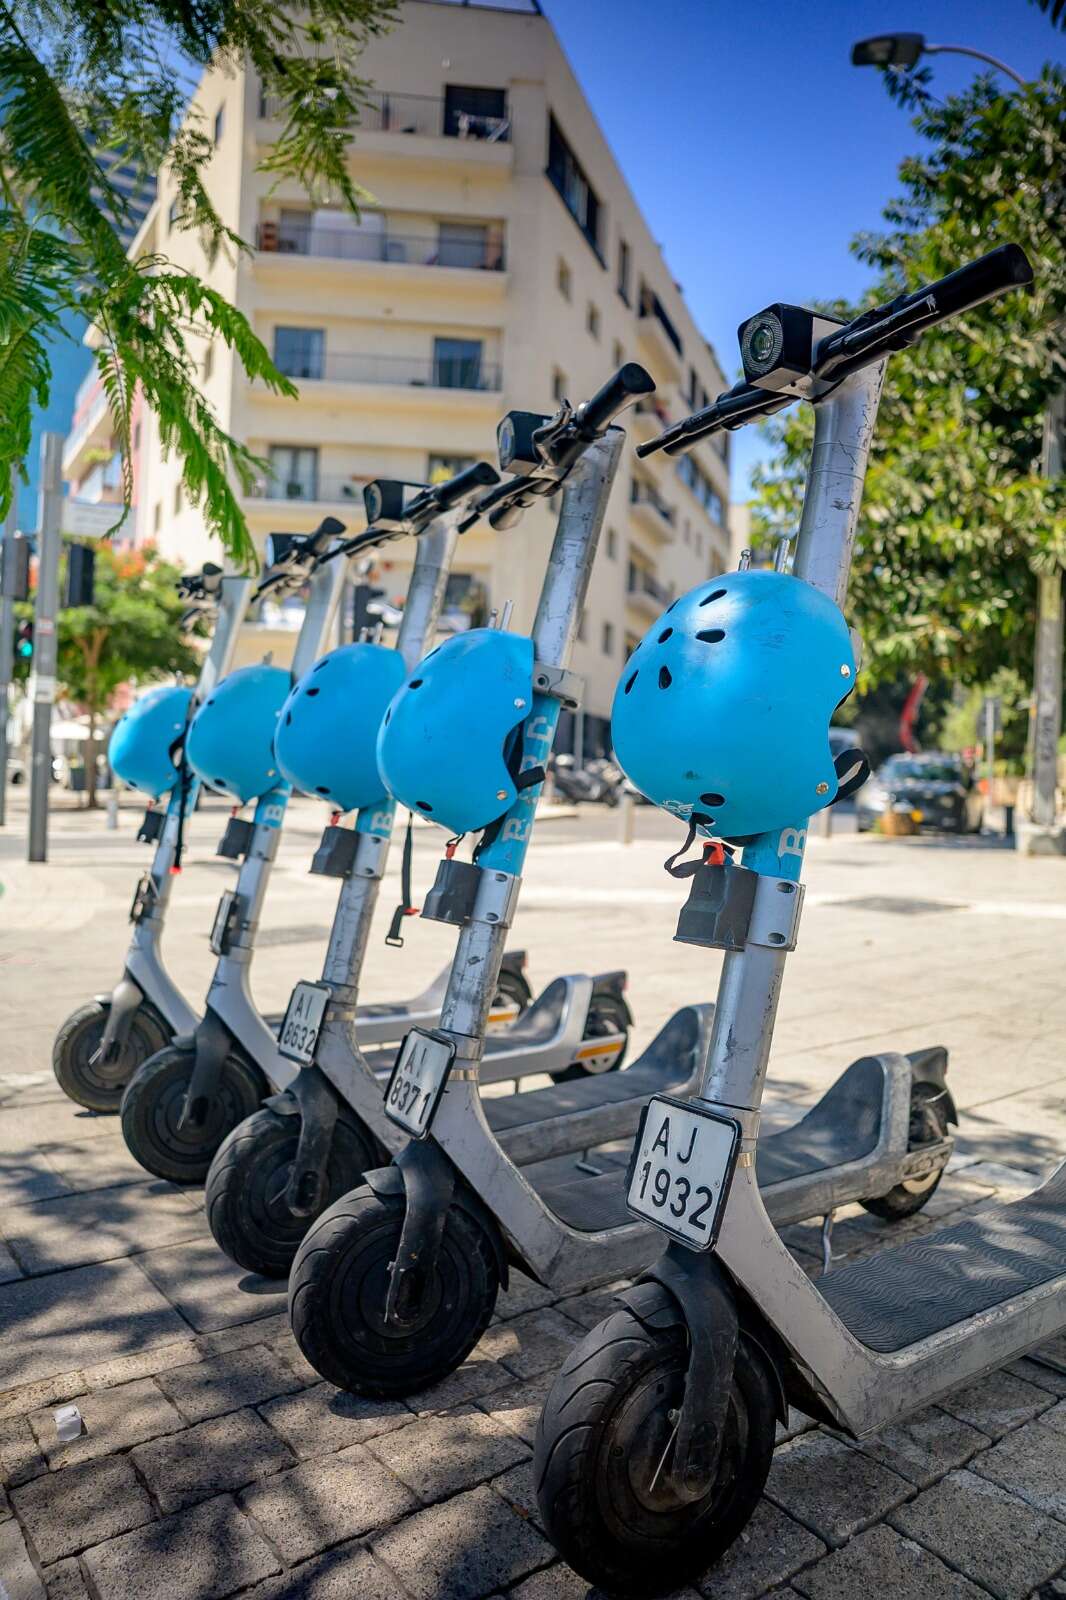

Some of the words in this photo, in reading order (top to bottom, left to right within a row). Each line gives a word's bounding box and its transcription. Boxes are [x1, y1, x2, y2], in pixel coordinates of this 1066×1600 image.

[283, 1022, 317, 1055] 8632
[390, 1077, 432, 1125] 8371
[651, 1117, 698, 1165] AJ
[639, 1160, 713, 1231] 1932
